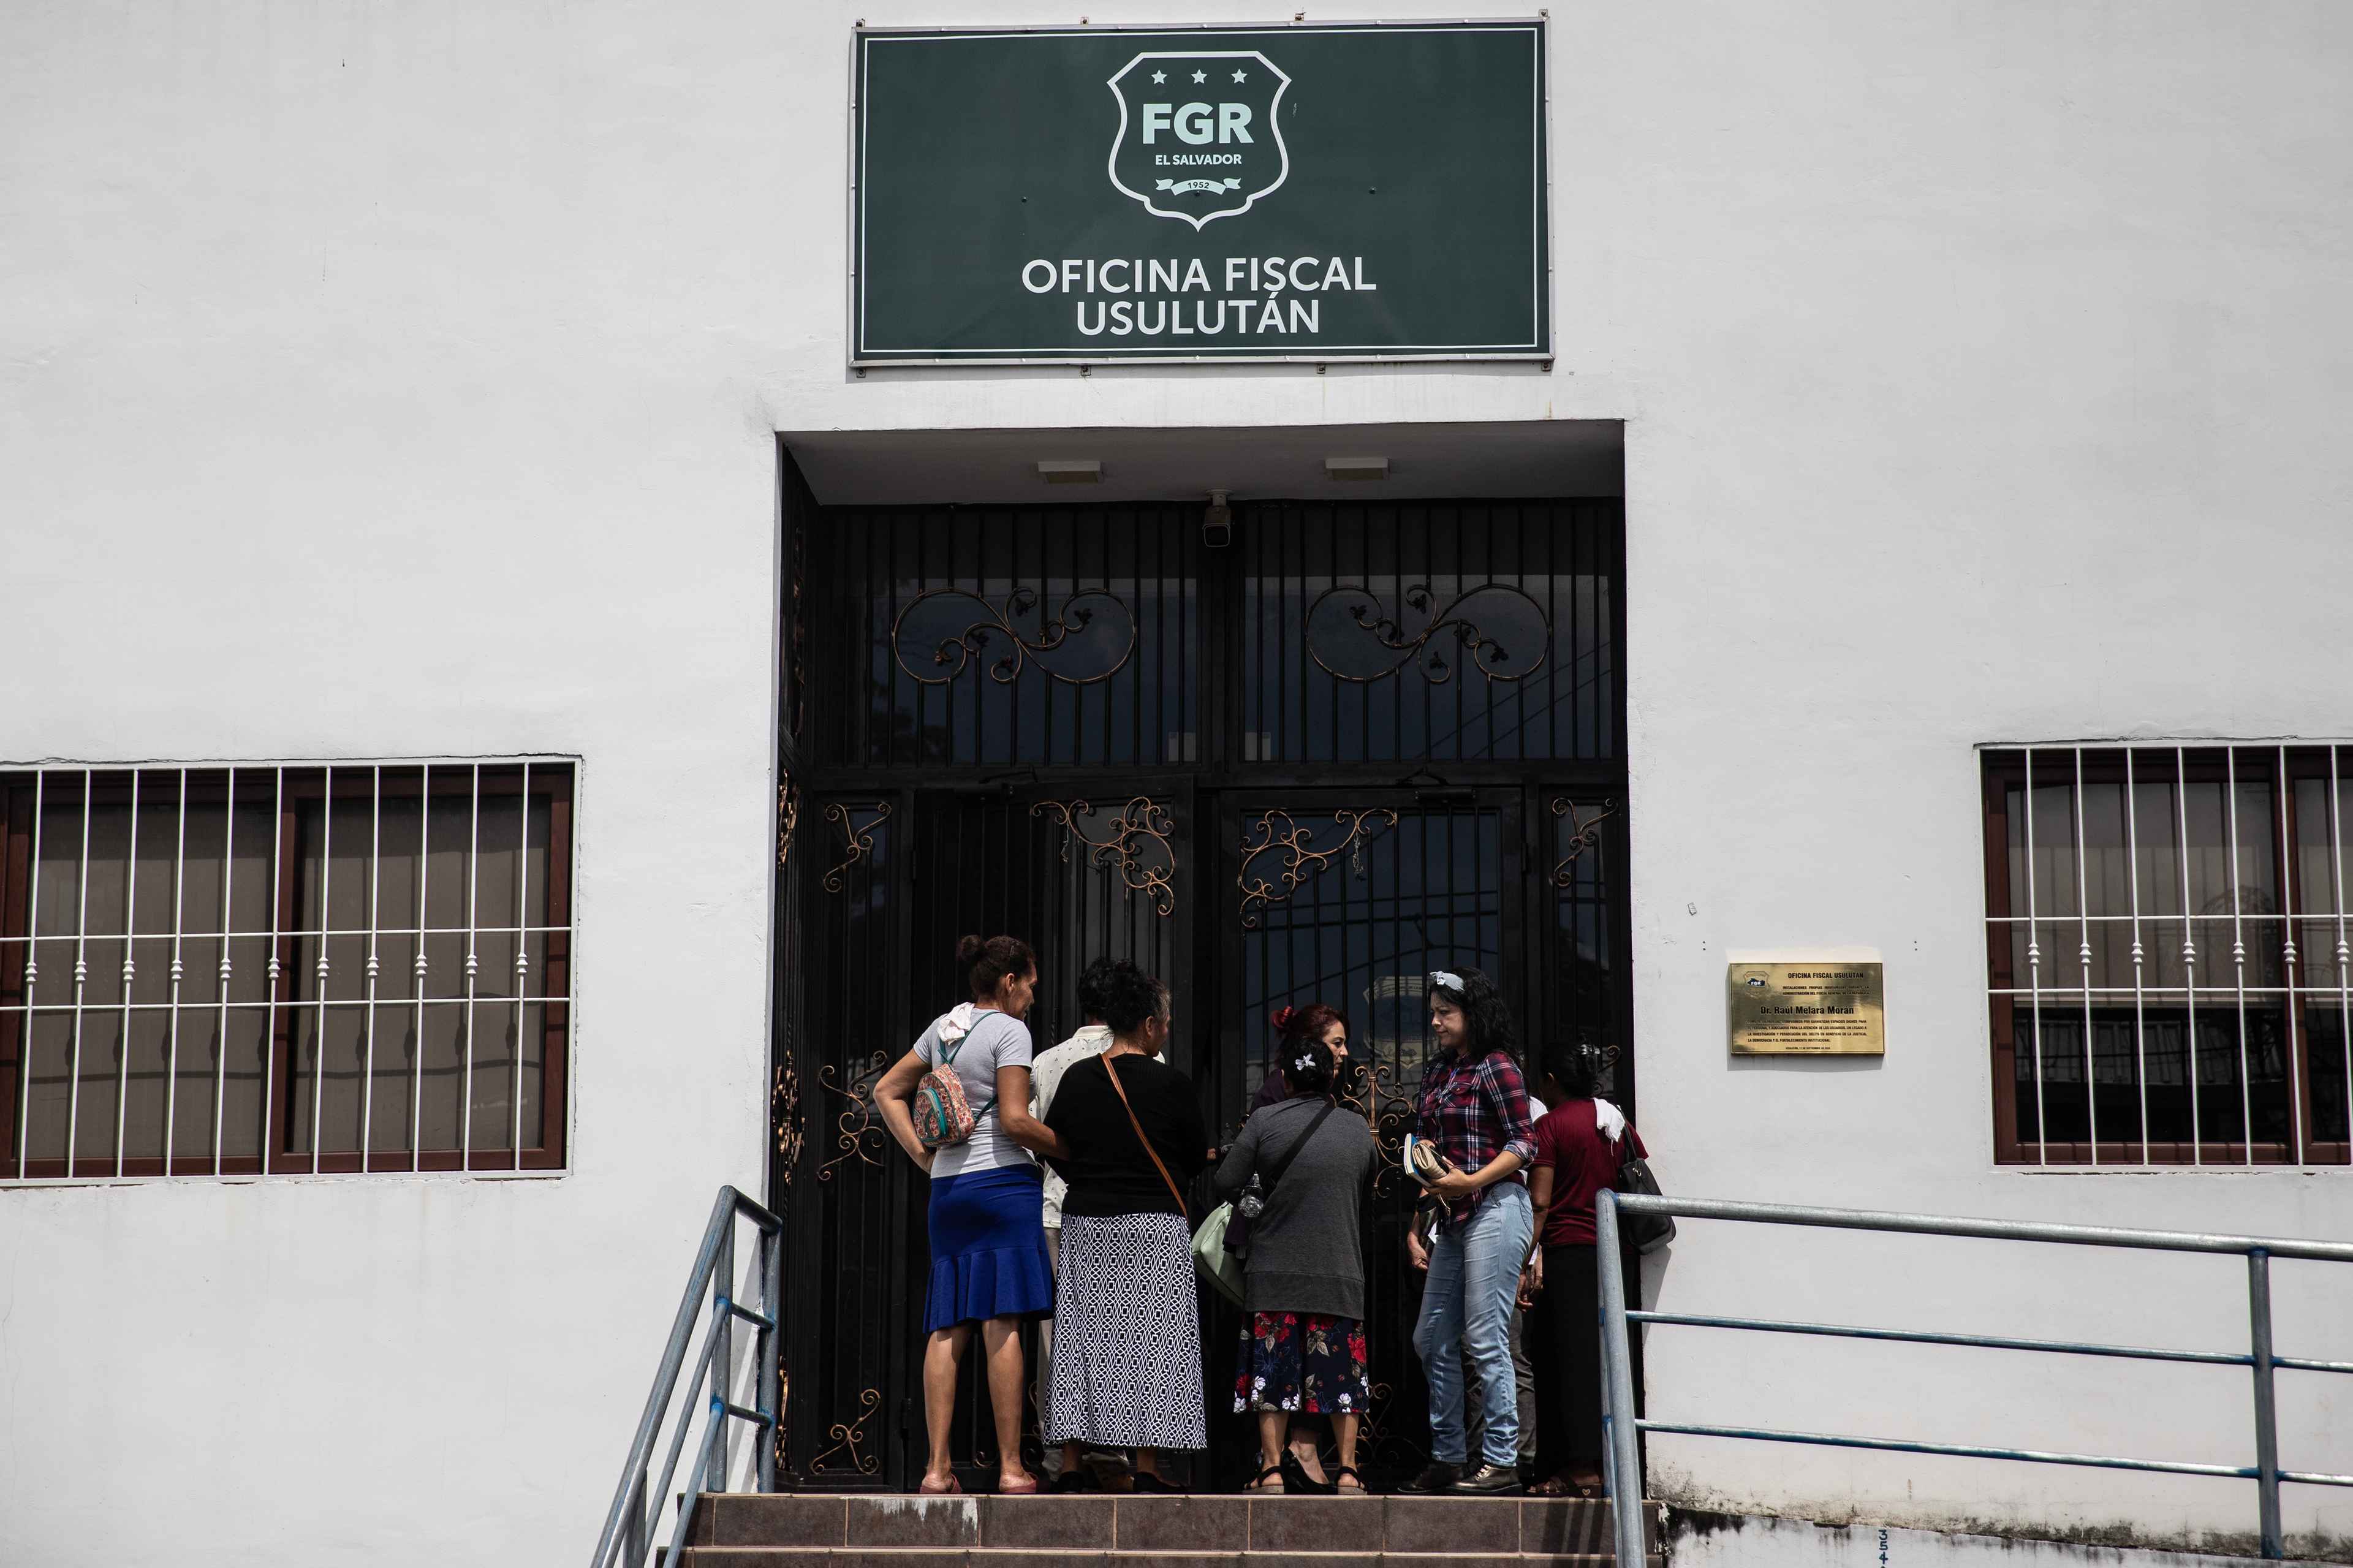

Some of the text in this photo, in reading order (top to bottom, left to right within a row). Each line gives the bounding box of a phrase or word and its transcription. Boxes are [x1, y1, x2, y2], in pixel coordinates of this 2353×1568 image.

[1143, 102, 1254, 145] FGR
[1156, 154, 1242, 165] EL SALVADOR
[1021, 256, 1377, 294] OFICINA FISCAL
[1077, 292, 1319, 336] USULUTÁN
